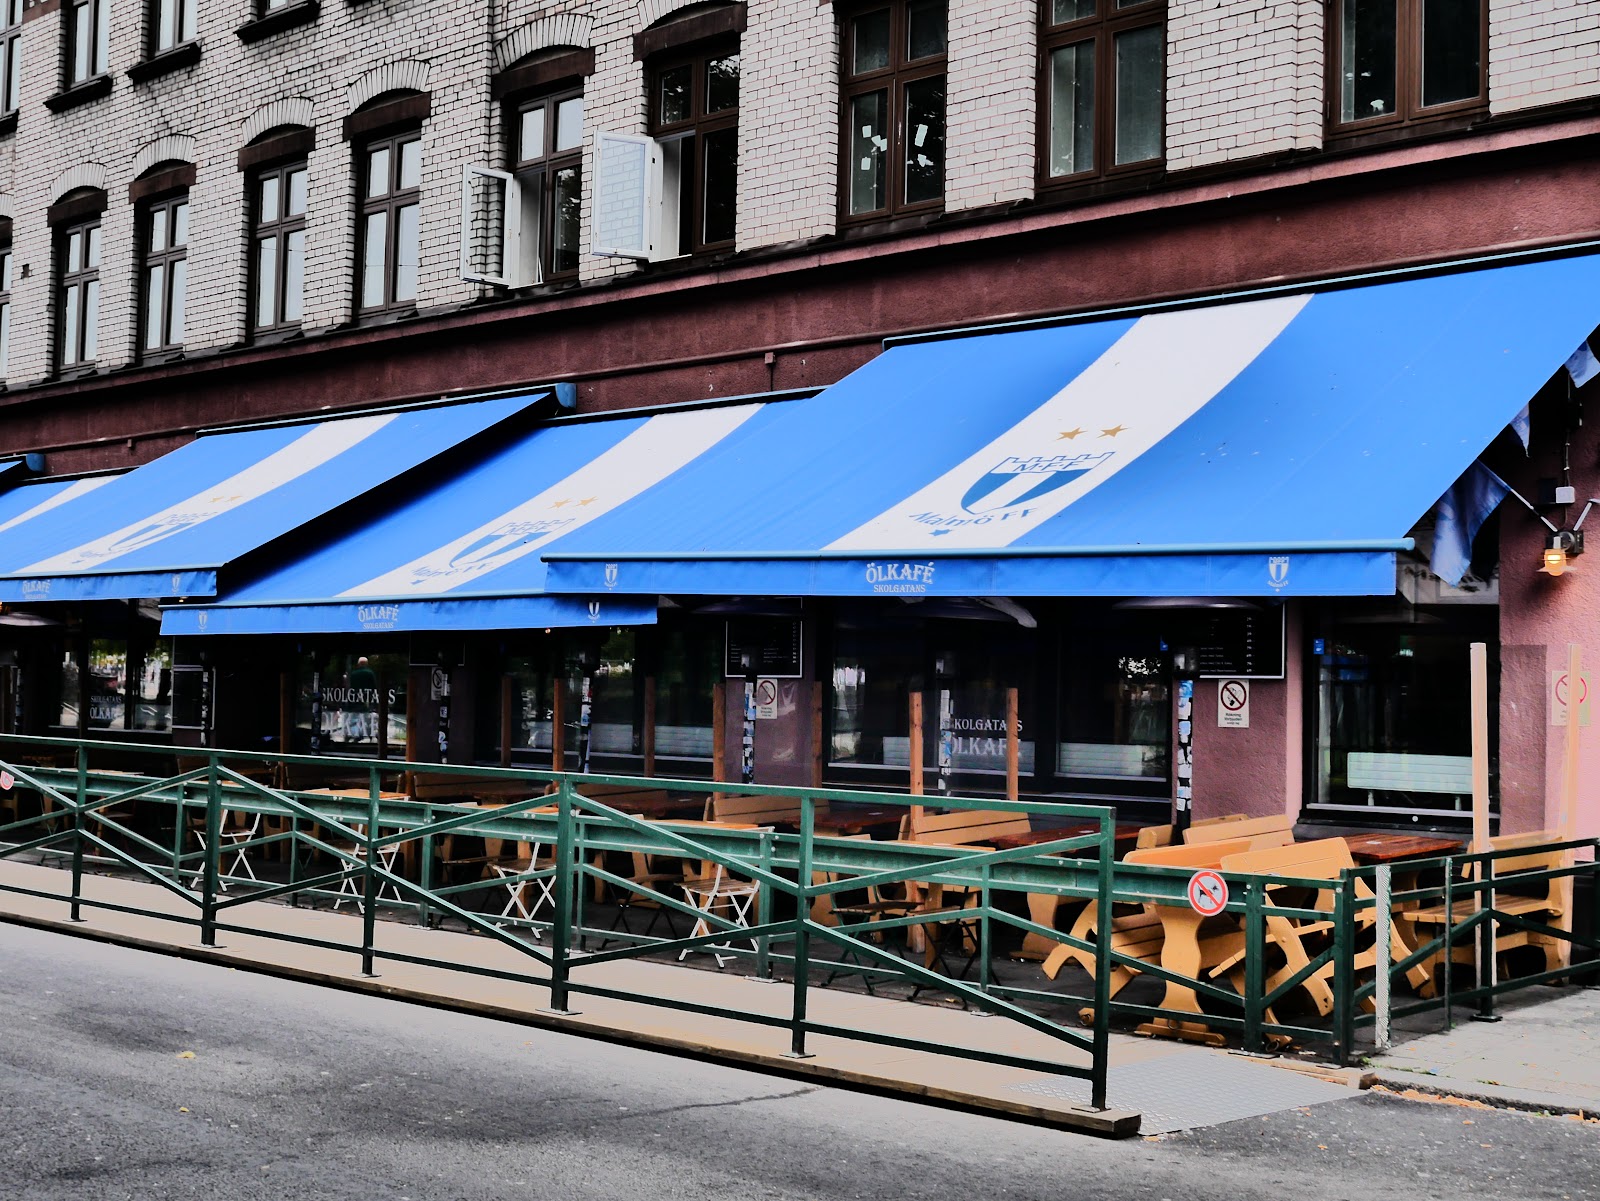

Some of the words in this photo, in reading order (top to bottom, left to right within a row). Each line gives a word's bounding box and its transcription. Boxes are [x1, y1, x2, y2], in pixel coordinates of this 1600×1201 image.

[1000, 507, 1039, 521] FF
[865, 561, 936, 585] ÖLKAFÉ
[873, 584, 927, 593] SKOLGATANS
[357, 604, 399, 622] ÖLKAFÉ
[321, 687, 396, 704] SKOLGATAS
[954, 718, 1023, 731] KOLGATAS
